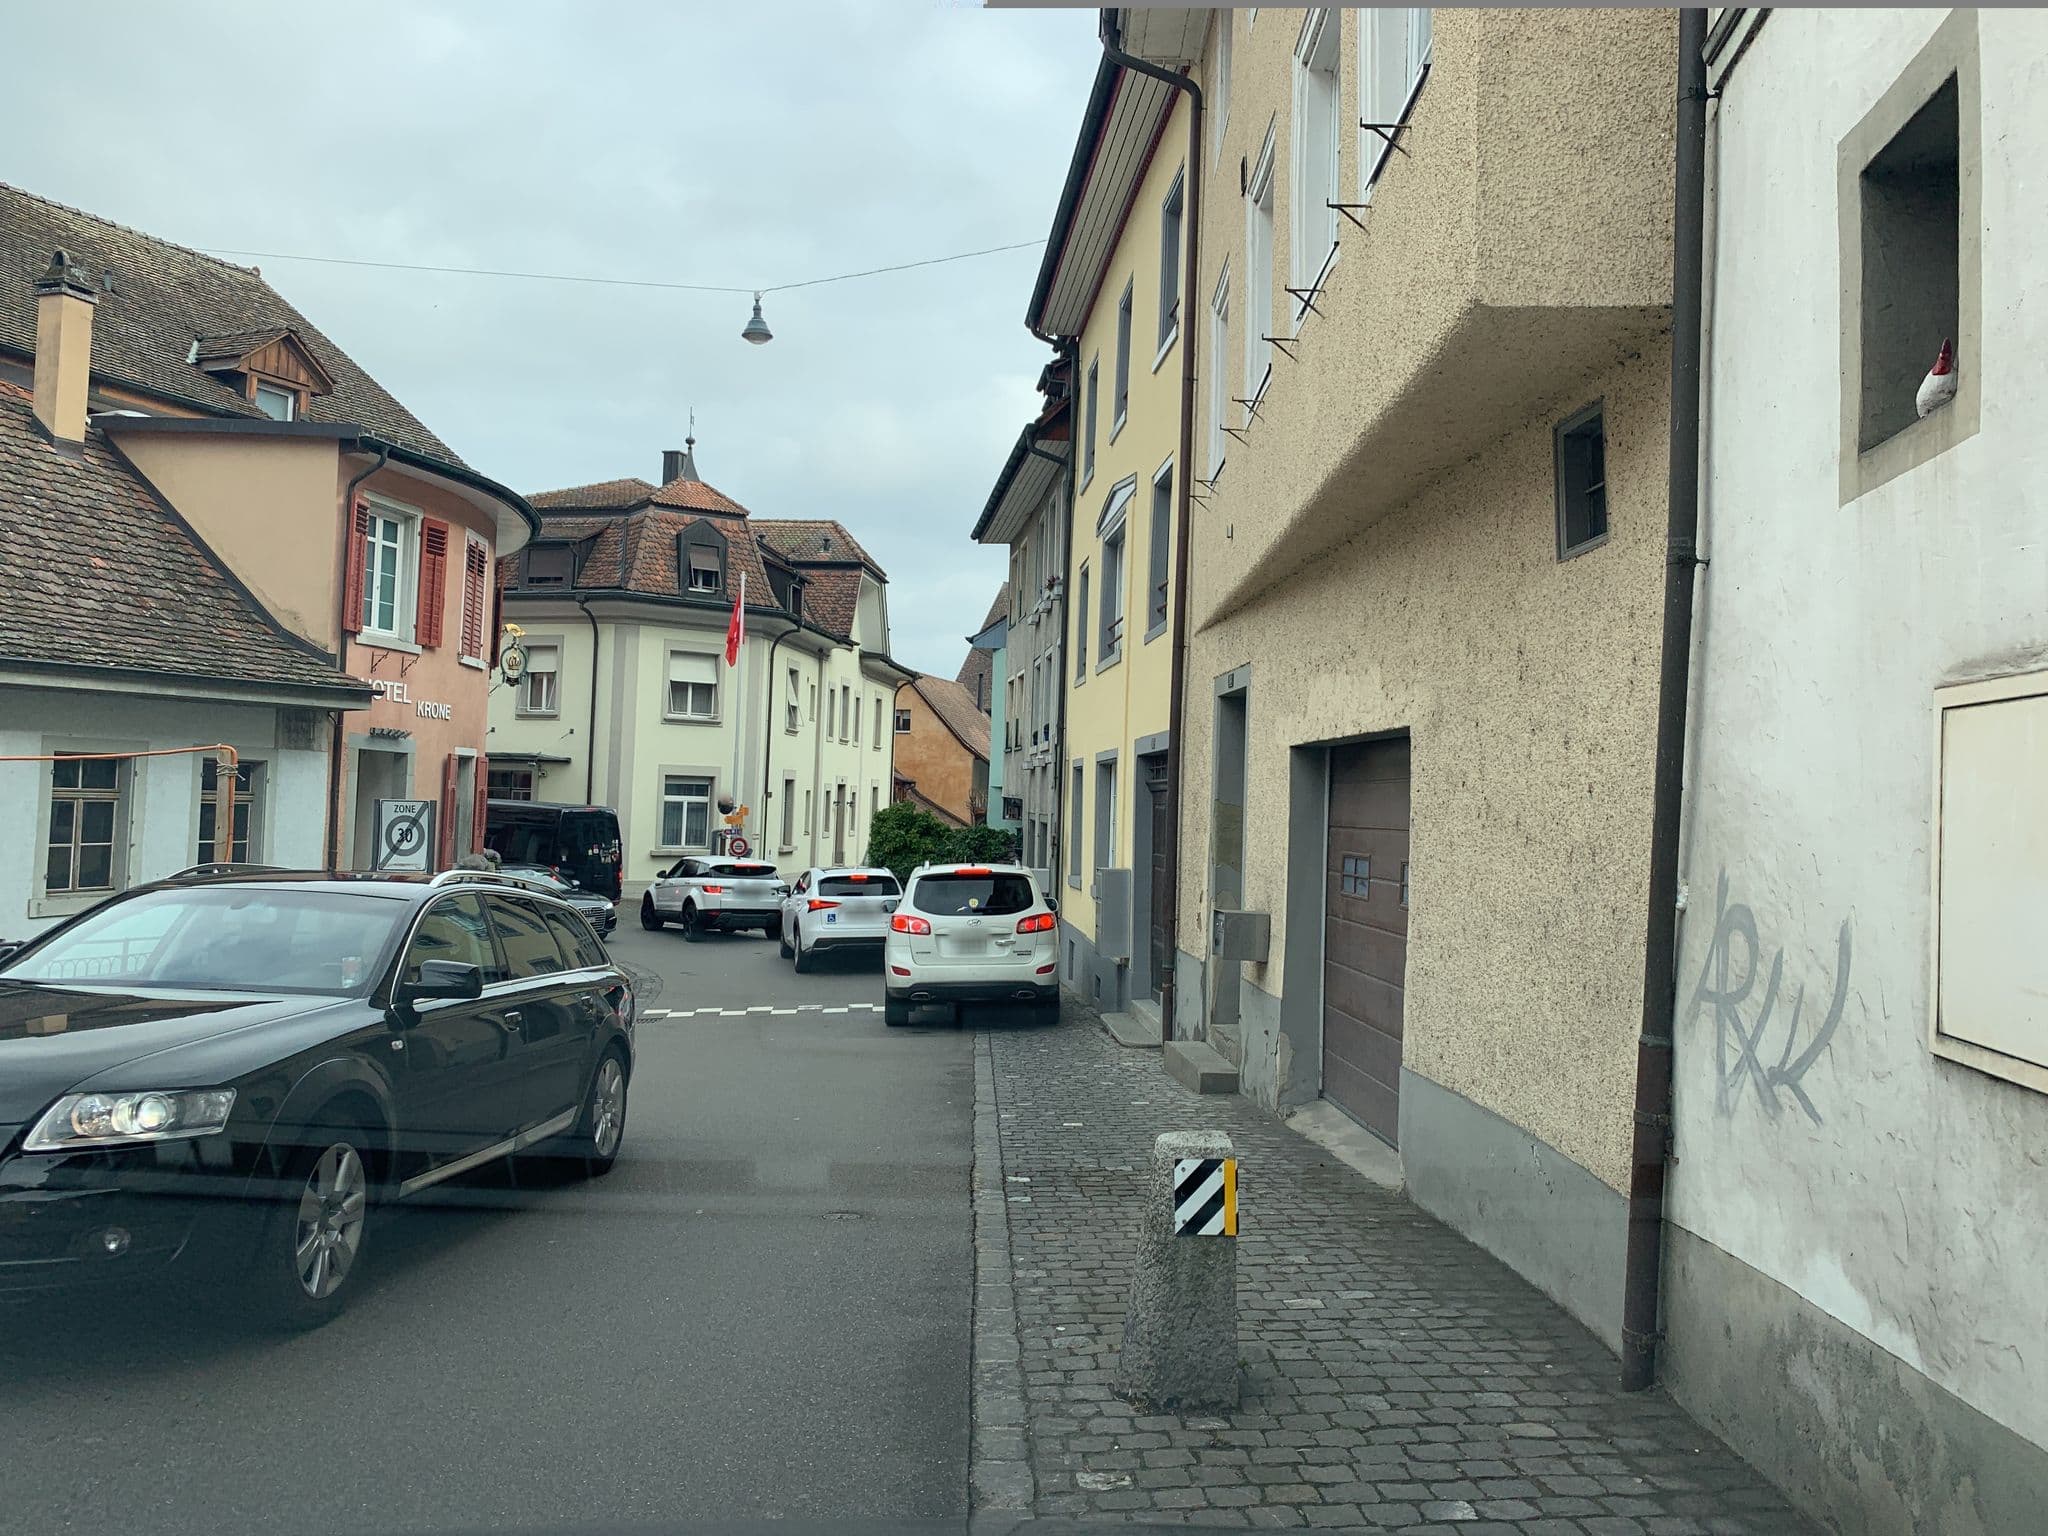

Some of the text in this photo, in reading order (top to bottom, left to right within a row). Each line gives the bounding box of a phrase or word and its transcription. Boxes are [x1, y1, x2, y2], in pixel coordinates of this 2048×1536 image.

[360, 677, 451, 720] OTEL KRONE
[394, 804, 416, 817] ZONE
[397, 828, 413, 843] 30
